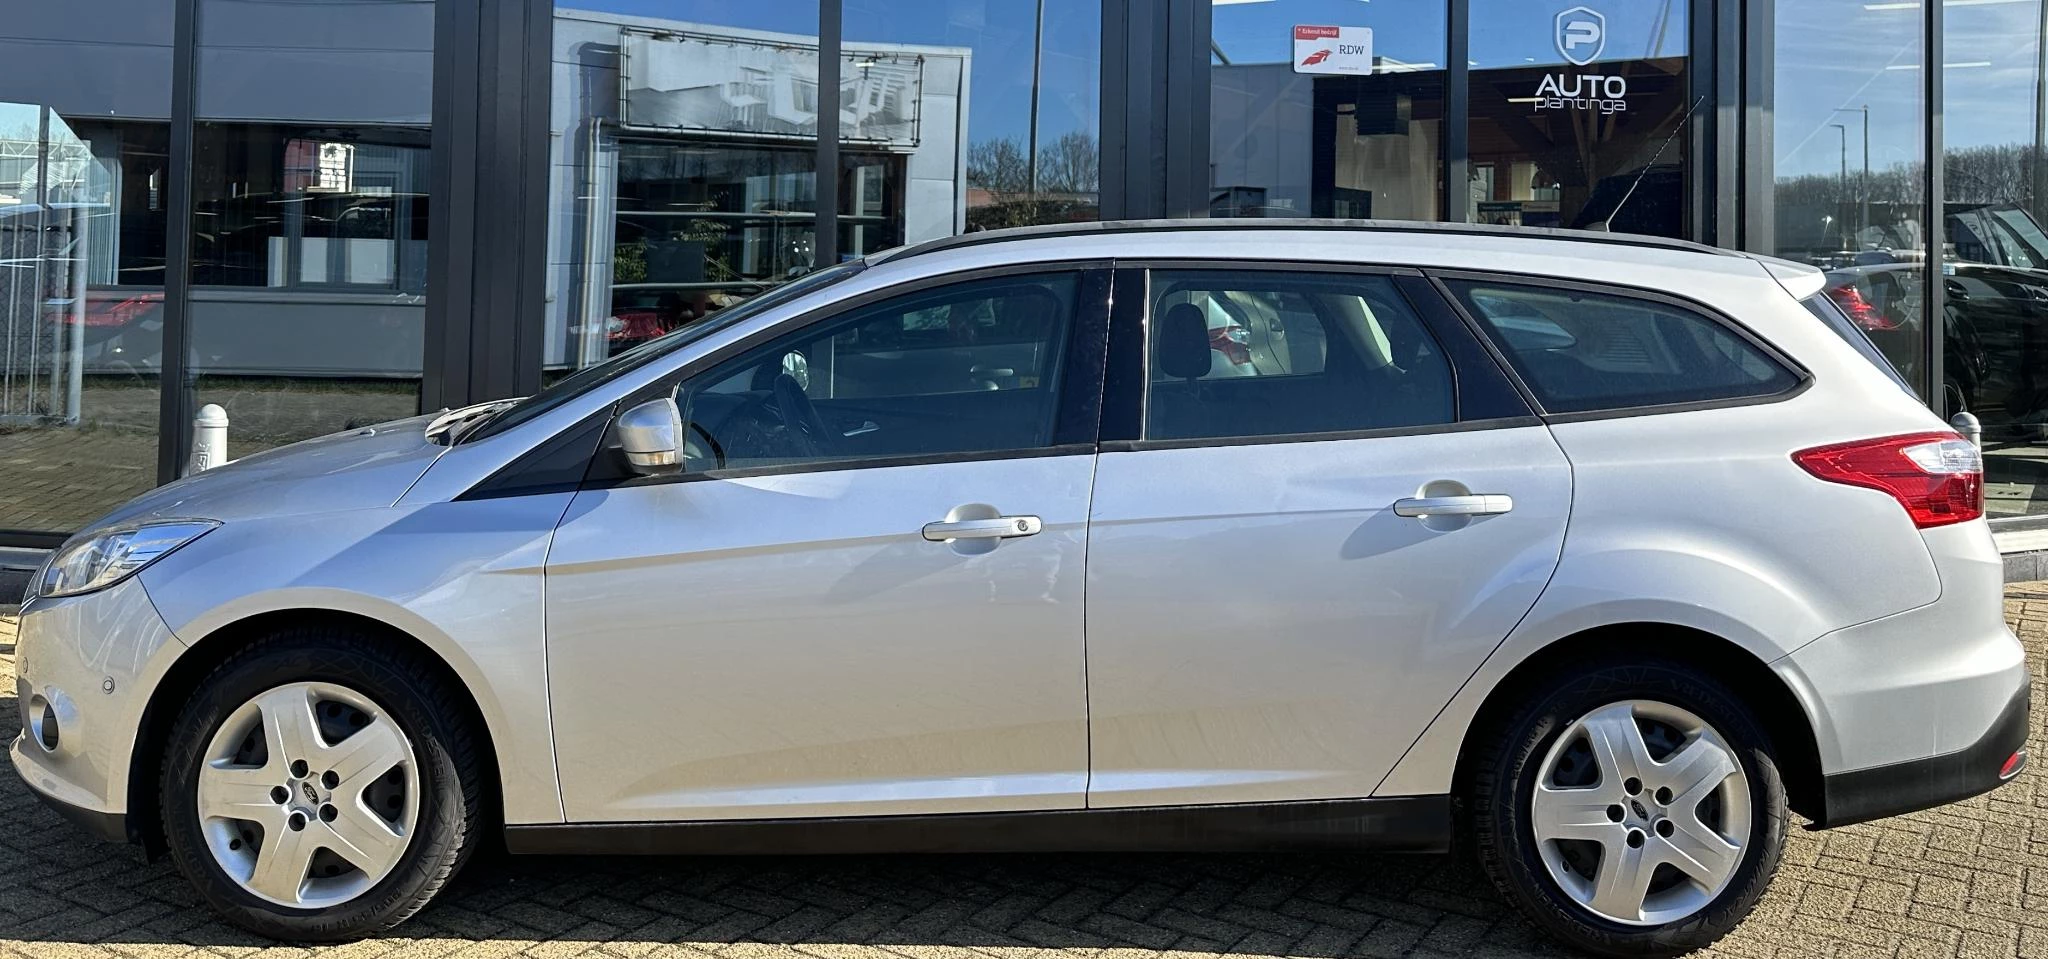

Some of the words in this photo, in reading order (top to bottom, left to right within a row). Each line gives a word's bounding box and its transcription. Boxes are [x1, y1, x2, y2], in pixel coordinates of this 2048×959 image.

[1565, 21, 1600, 49] P
[1339, 45, 1364, 55] RDW
[1535, 73, 1626, 98] AUTO
[1534, 95, 1626, 115] plantinga
